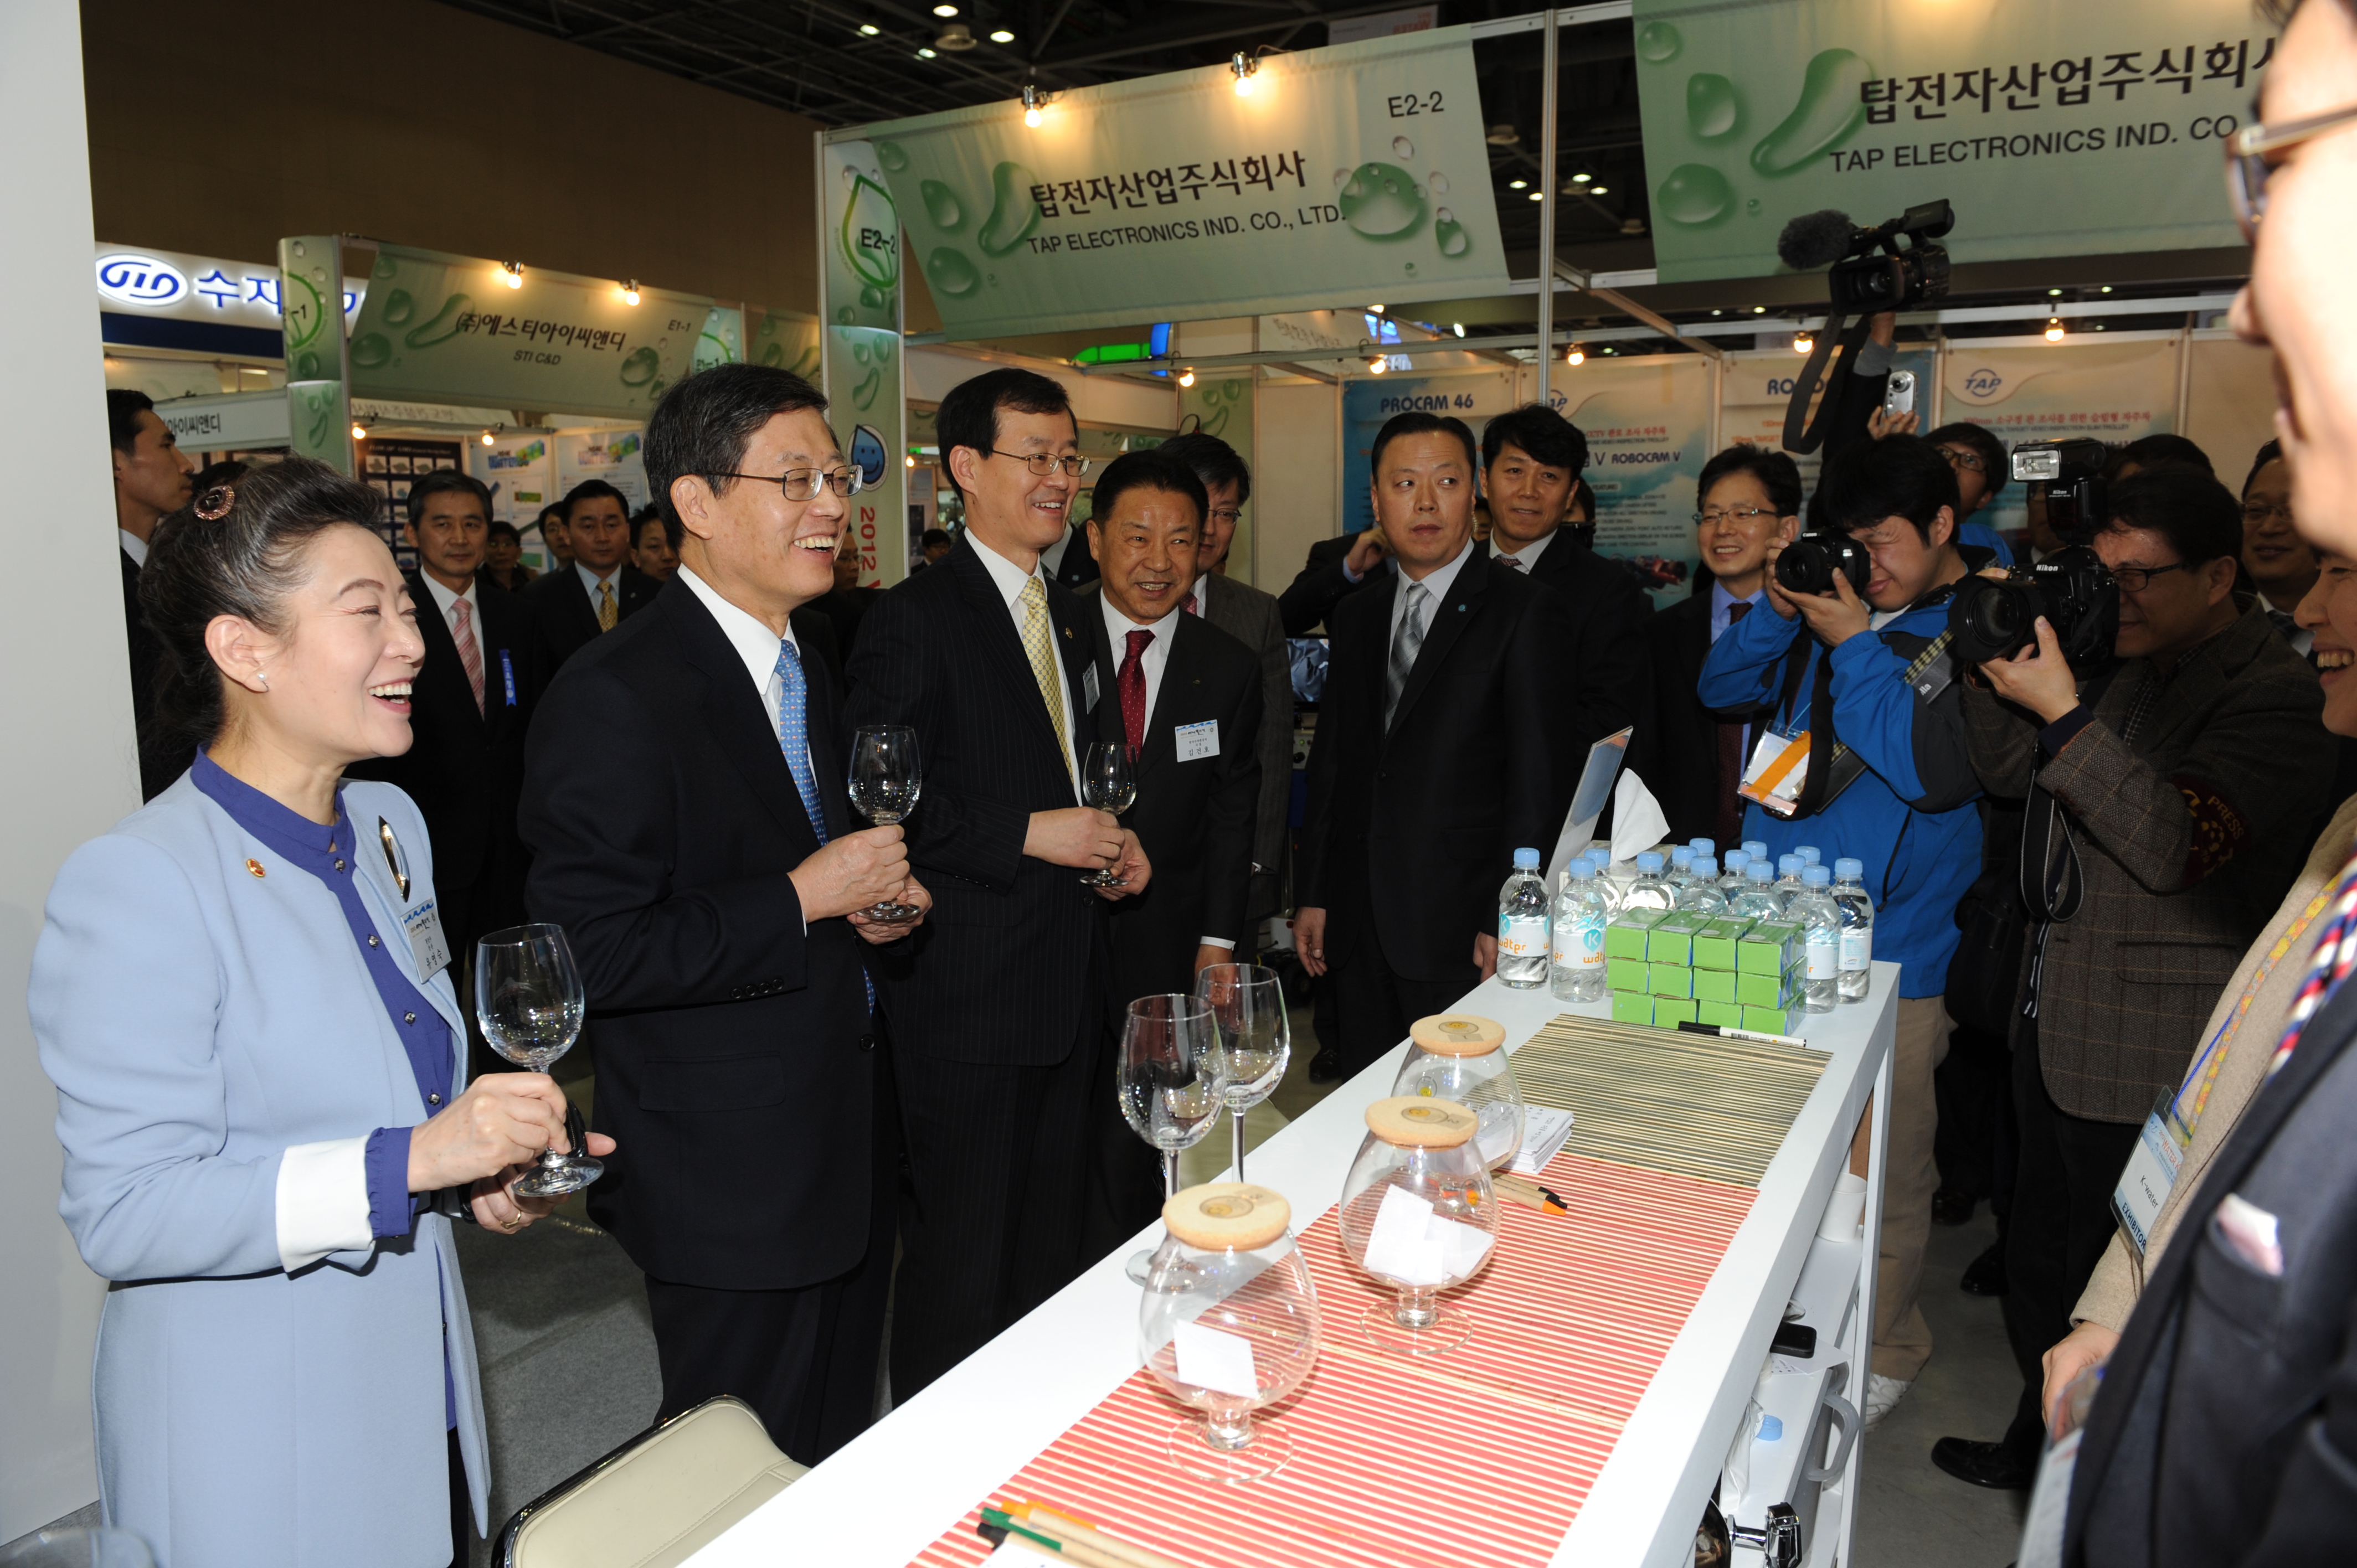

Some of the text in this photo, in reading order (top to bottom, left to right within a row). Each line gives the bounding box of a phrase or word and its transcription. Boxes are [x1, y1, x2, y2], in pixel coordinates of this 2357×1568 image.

[1388, 91, 1444, 118] E2-2
[1830, 149, 1884, 172] TAP
[1893, 126, 2106, 167] ELECTRONICS
[2115, 121, 2178, 148] IND.
[1030, 150, 1306, 218] 탑전자산업주식회사
[861, 228, 896, 255] E2-2
[1027, 204, 1346, 255] TAP ELECTRONICS IND. CO., LTD.
[455, 311, 626, 352] (주)에스티아이씨앤디
[667, 319, 691, 333] E1-1
[513, 350, 562, 366] STI C&D
[1965, 378, 2002, 390] TAP
[1380, 393, 1474, 412] PROCAM 46
[1611, 452, 1670, 464] ROBOCAM
[860, 506, 877, 571] 2012
[2207, 795, 2244, 840] PRESS
[1588, 932, 1599, 947] K
[2139, 1174, 2159, 1209] K-water
[2122, 1201, 2147, 1251] EXHIBITOR
